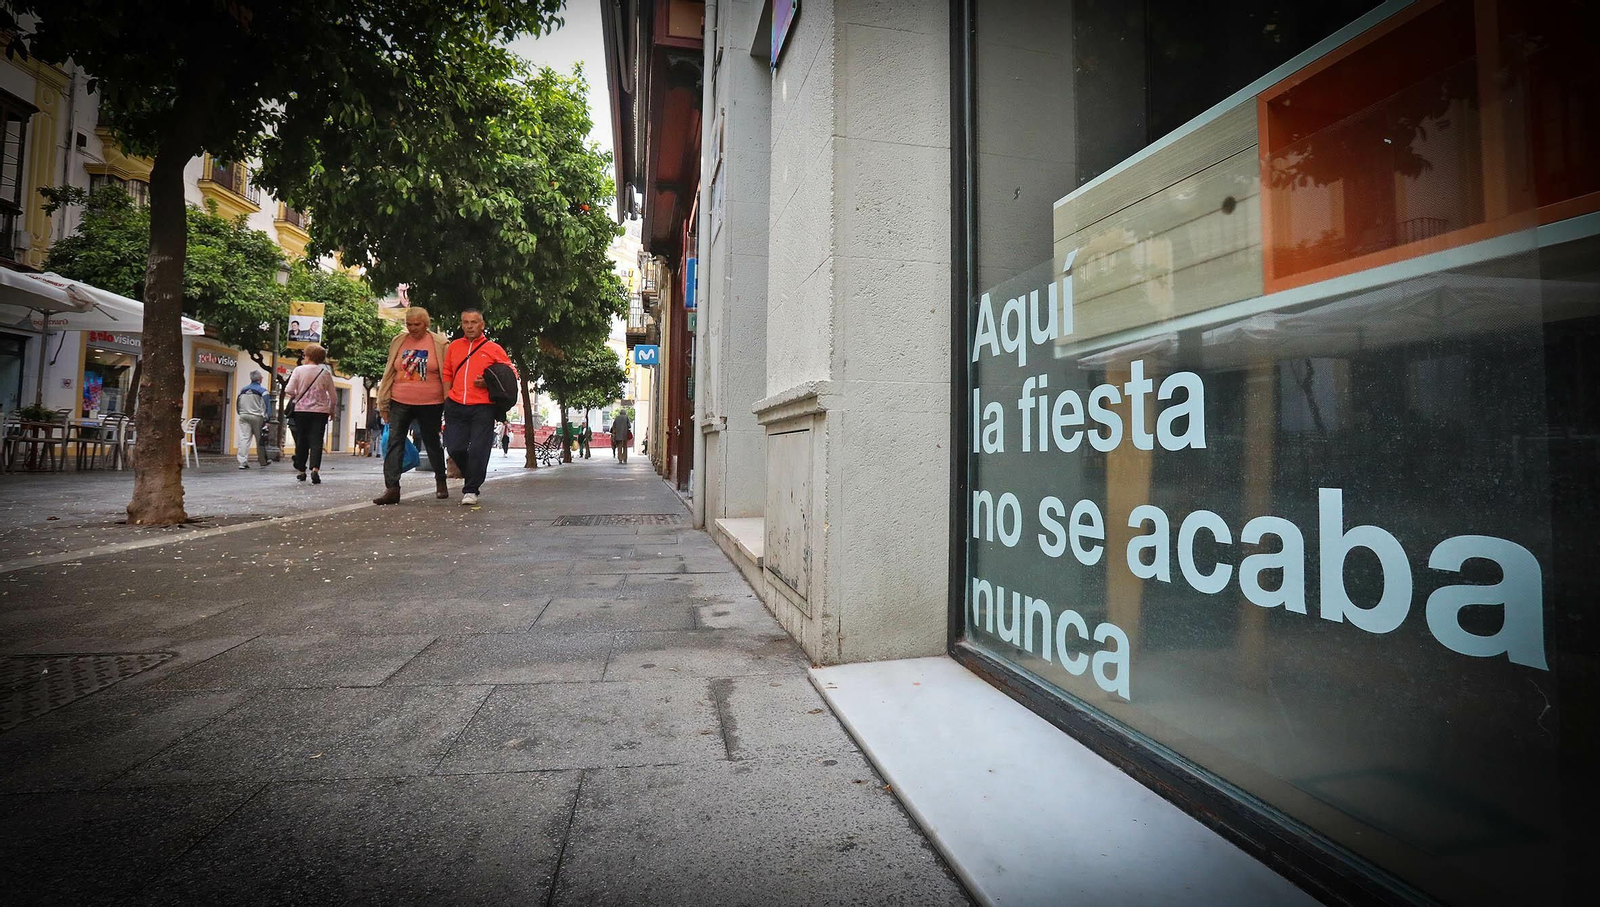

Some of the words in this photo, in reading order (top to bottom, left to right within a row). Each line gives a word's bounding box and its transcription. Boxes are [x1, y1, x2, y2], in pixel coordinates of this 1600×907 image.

[972, 250, 1077, 366] Aquí
[972, 388, 1005, 453] la
[1018, 359, 1207, 452] fiesta
[972, 489, 1022, 547] no
[1037, 495, 1105, 566] se
[1126, 487, 1550, 671] acaba
[972, 576, 1131, 700] nunca
